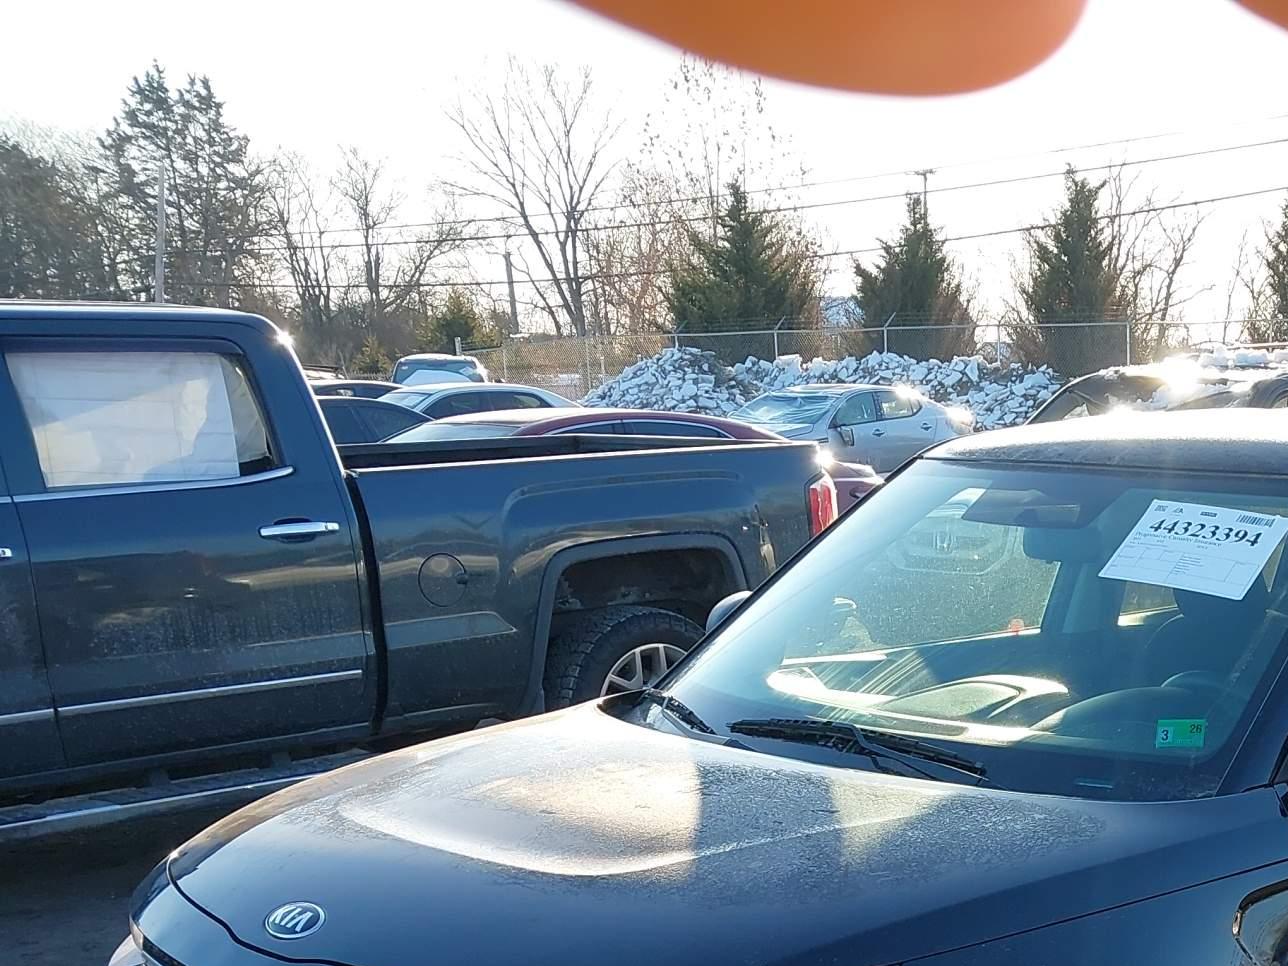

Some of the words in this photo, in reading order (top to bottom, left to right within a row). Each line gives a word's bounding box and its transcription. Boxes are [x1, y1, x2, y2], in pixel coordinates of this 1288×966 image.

[1149, 518, 1264, 548] 44323394
[1161, 729, 1169, 741] 3
[1190, 724, 1202, 734] 26
[268, 905, 314, 933] KIA
